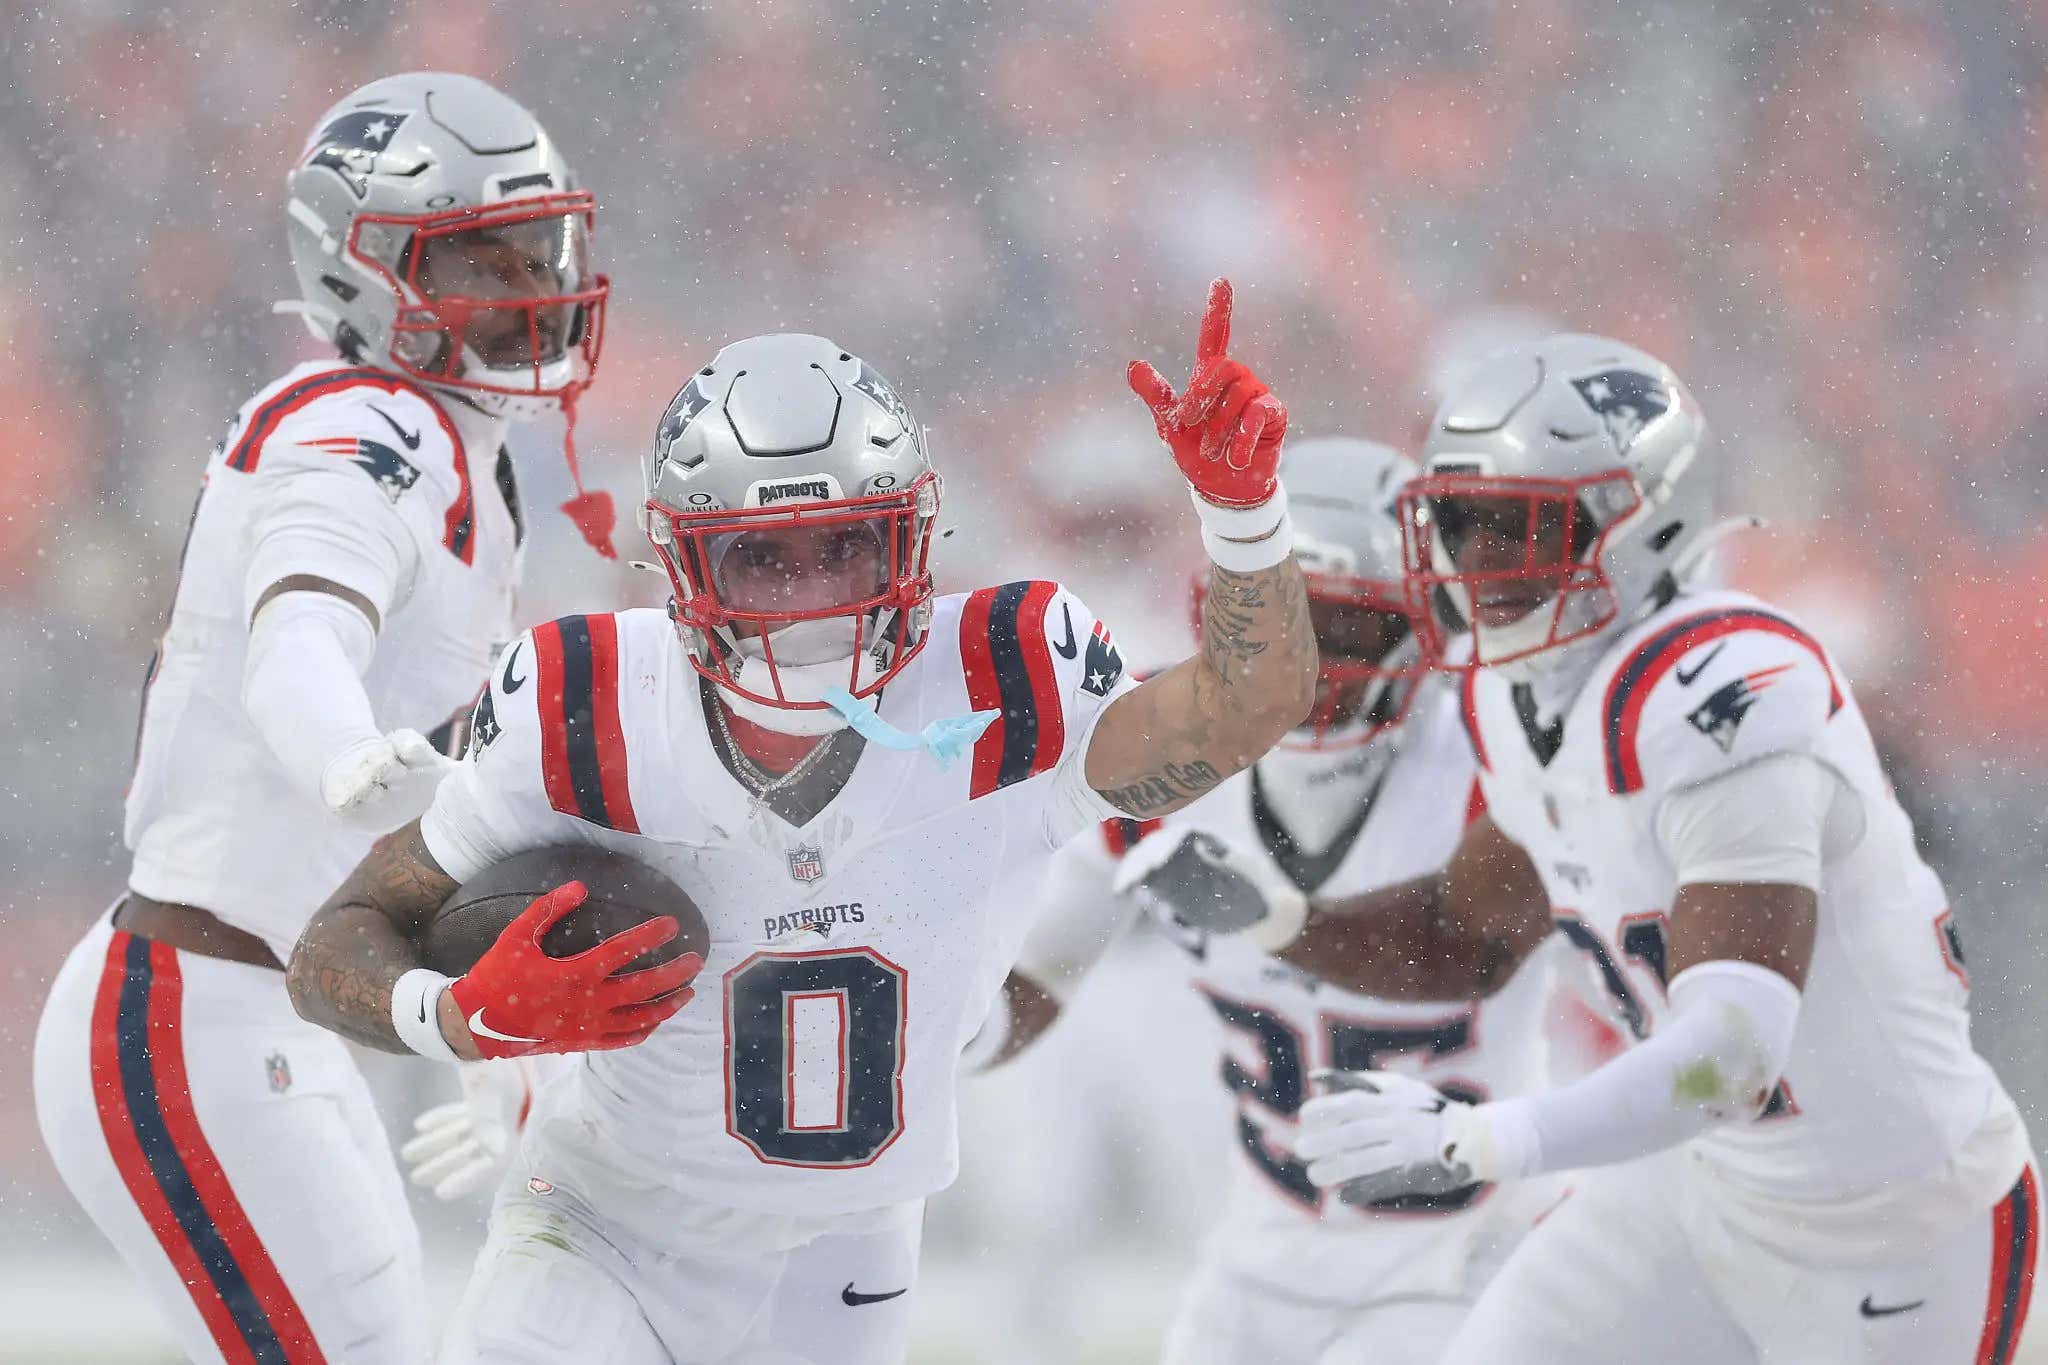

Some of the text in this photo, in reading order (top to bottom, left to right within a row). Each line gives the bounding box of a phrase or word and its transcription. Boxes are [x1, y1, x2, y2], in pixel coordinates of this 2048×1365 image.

[758, 481, 830, 506] PATRIOTS
[685, 504, 720, 512] OAKLEY
[793, 863, 821, 880] NFL
[764, 903, 865, 940] PATRIOTS
[722, 946, 908, 1170] 0
